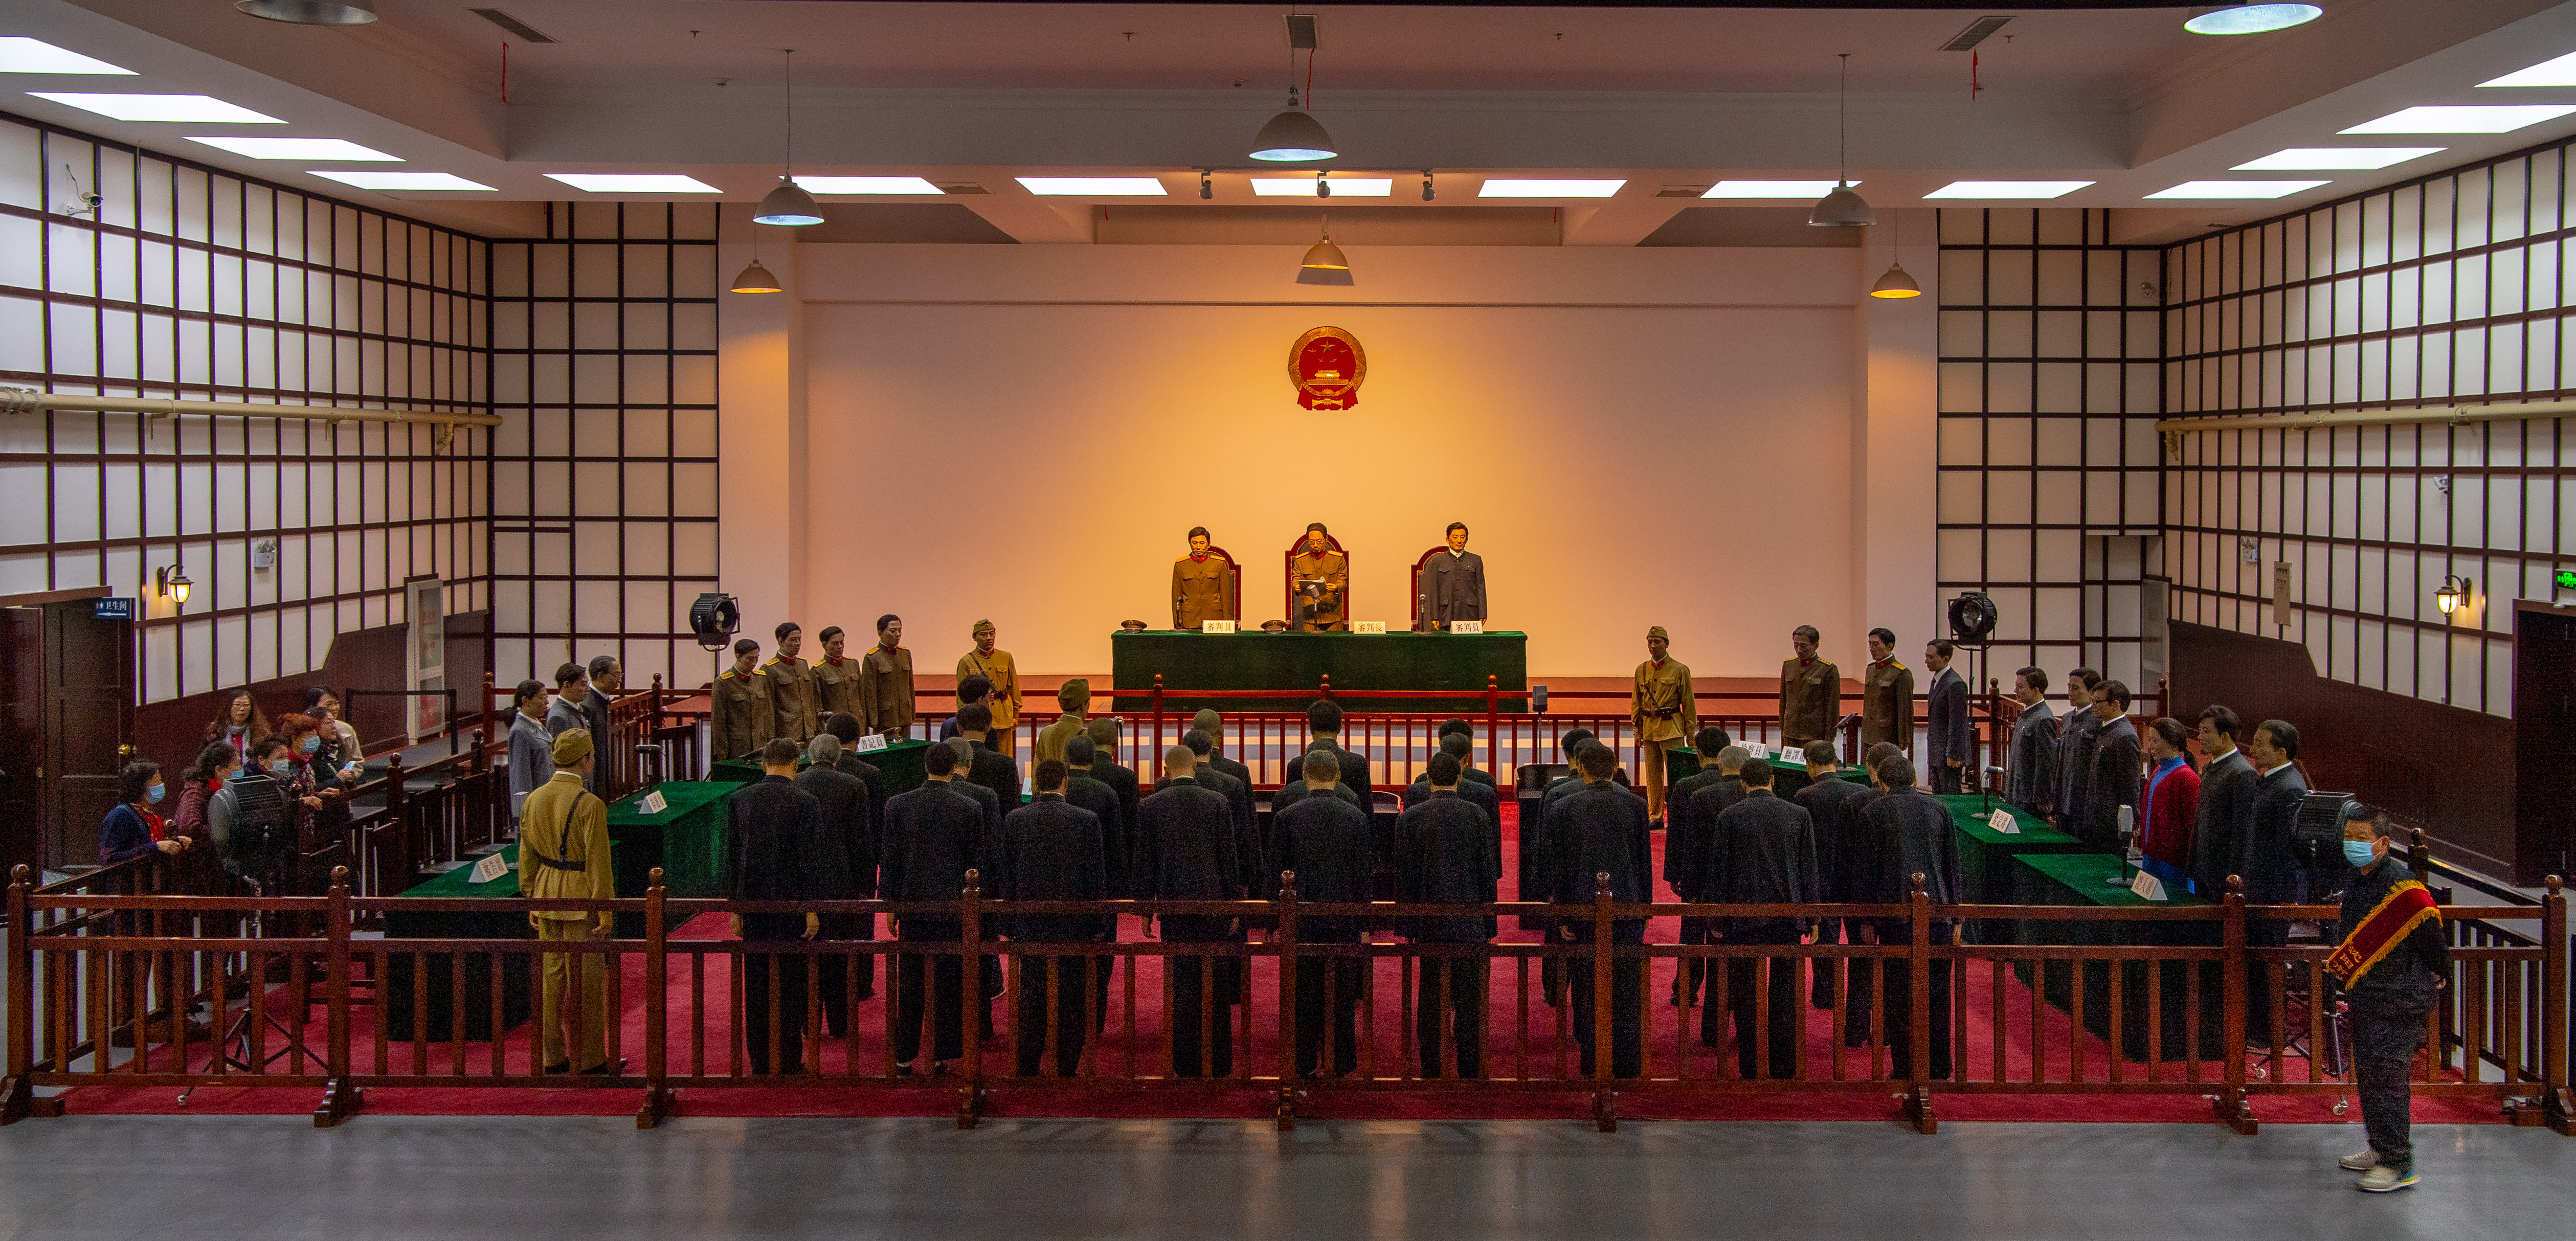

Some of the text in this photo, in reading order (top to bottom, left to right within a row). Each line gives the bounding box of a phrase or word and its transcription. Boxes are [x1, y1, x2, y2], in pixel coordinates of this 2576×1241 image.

[106, 601, 127, 611] 卫生间
[1207, 622, 1231, 631] 審判員
[1358, 623, 1382, 632] 審判長
[1456, 623, 1480, 632] 審判員
[861, 737, 883, 750] 書記員
